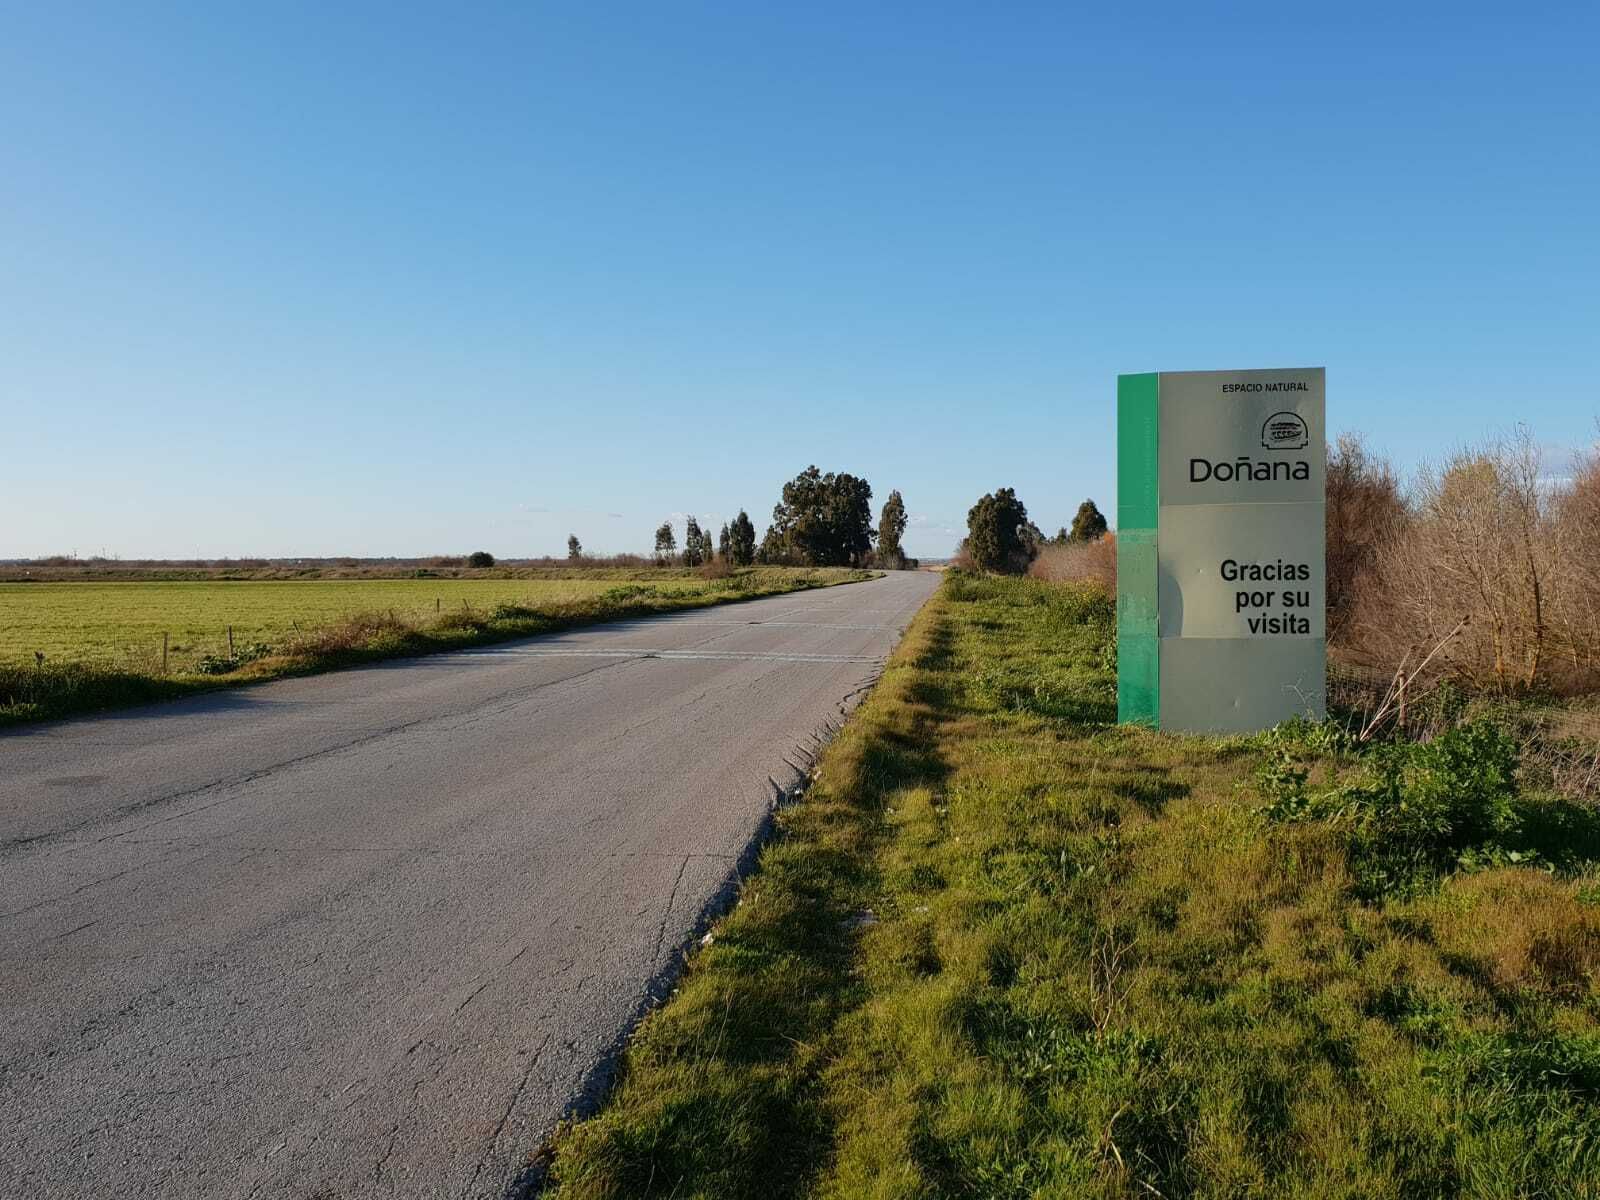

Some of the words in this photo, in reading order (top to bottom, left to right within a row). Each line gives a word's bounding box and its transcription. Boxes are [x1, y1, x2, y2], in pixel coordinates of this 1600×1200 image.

[1222, 383, 1262, 393] ESPACIO
[1265, 382, 1309, 392] NATURAL
[1190, 456, 1310, 483] Doñana
[1220, 559, 1310, 581] Gracias
[1236, 590, 1275, 613] por
[1282, 590, 1310, 608] su
[1248, 612, 1310, 634] visita
